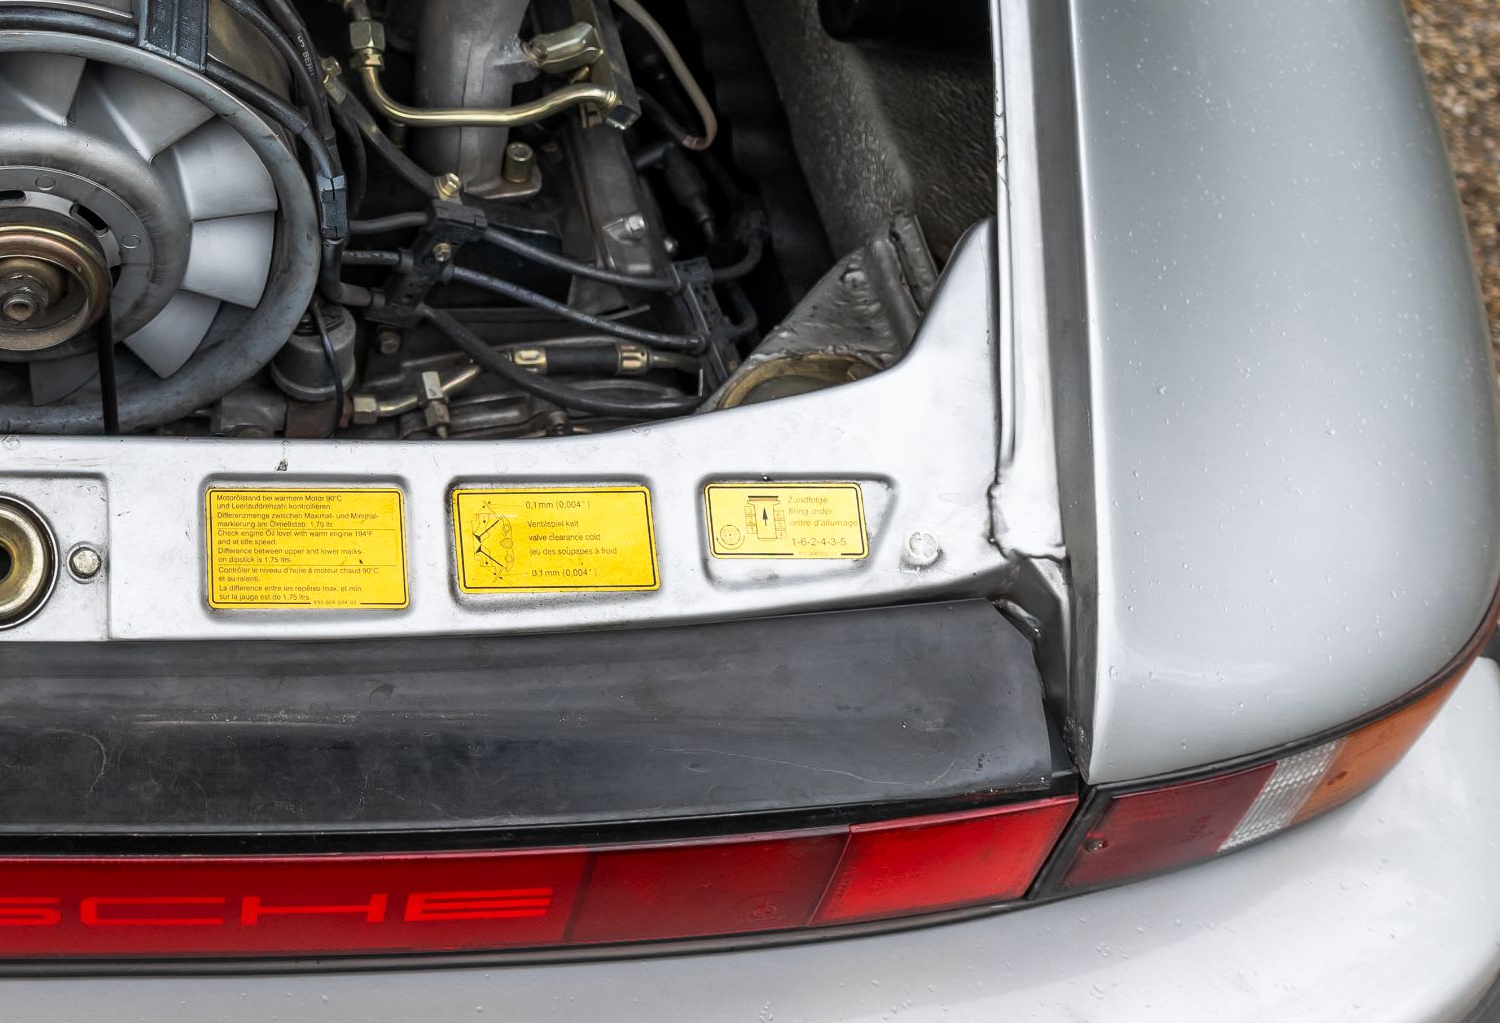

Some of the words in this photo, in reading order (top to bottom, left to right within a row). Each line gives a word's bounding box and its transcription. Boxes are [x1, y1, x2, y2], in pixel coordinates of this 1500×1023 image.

[526, 501, 537, 509] 0,1
[585, 533, 601, 541] cold
[792, 538, 847, 546] 1-6-2-4-3-5
[530, 548, 541, 557] jeu
[558, 548, 592, 556] soupapes
[601, 547, 617, 555] froid
[532, 570, 543, 578] 0,1
